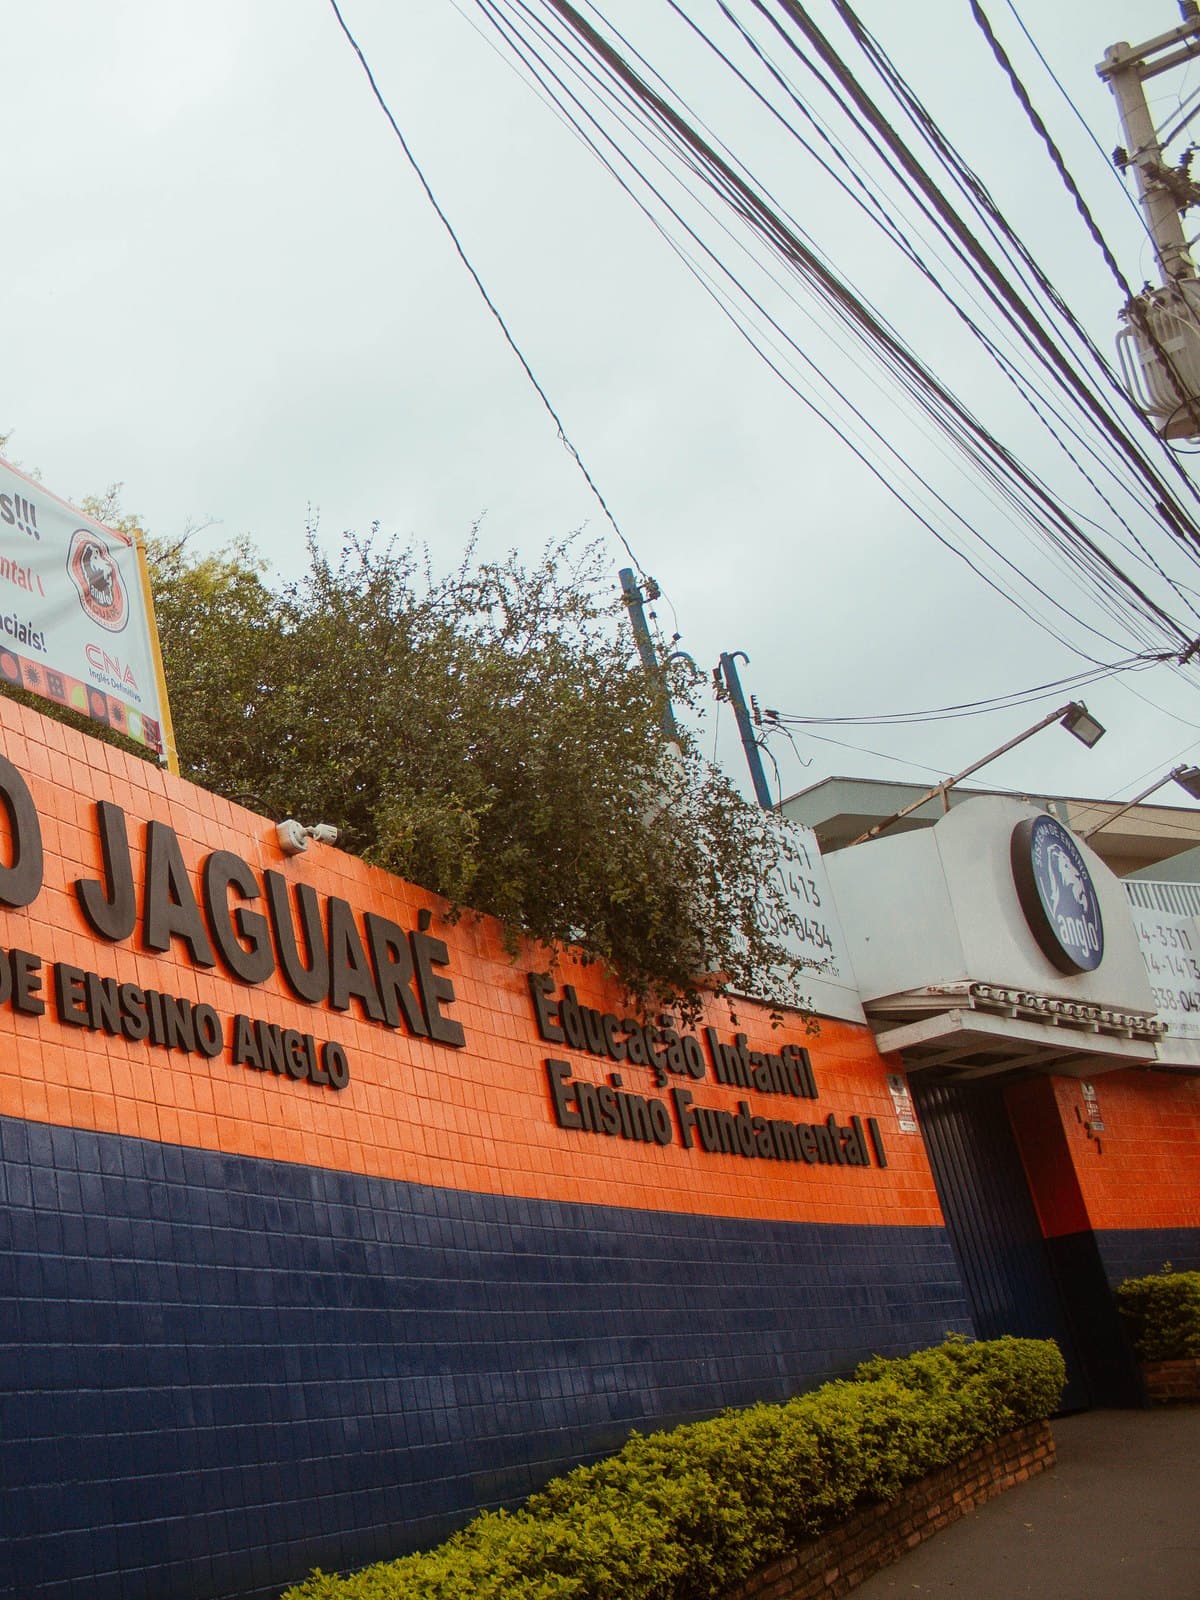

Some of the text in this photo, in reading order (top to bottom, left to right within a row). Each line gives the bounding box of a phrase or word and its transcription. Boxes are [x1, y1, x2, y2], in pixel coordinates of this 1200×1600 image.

[85, 643, 138, 690] CNA
[74, 800, 466, 1048] JAGUARÉ
[1057, 914, 1099, 958] anglo
[54, 962, 224, 1058] ENSINO
[232, 1014, 350, 1090] ANGLO
[528, 972, 819, 1099] Educação Infantil
[545, 1058, 672, 1146] Ensino
[672, 1088, 870, 1166] Fundamental
[867, 1117, 888, 1168] I
